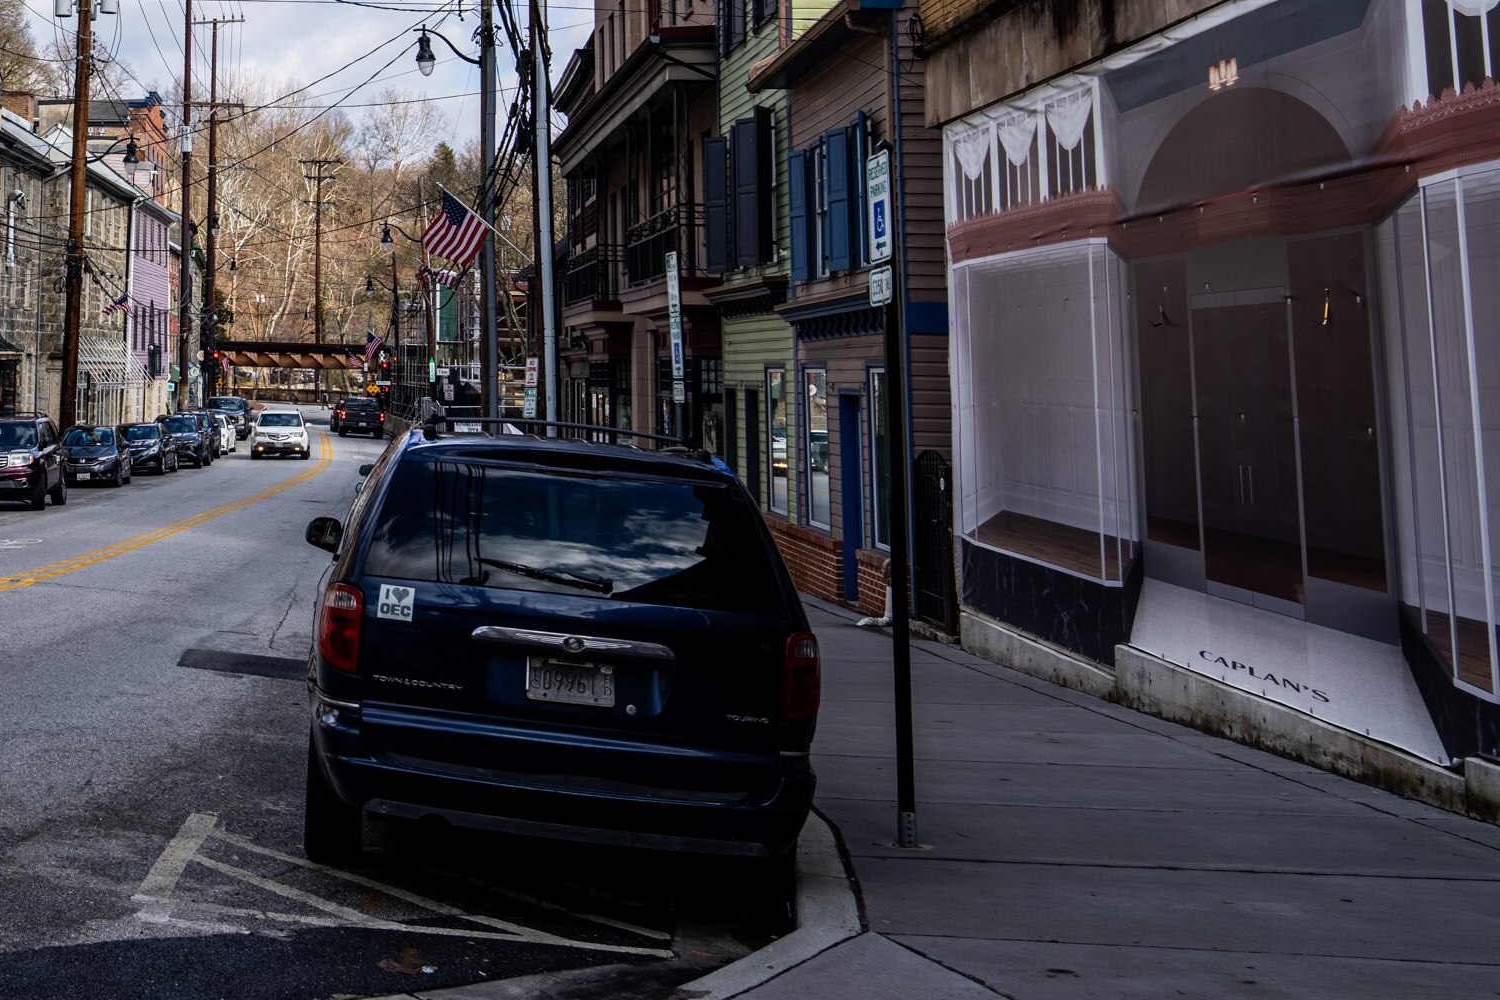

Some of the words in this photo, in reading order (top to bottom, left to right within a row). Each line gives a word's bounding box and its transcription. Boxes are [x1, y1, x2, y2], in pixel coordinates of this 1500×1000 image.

[385, 588, 390, 600] I
[379, 602, 412, 618] OEC
[373, 674, 403, 684] TOWN
[404, 678, 411, 686] &
[411, 680, 463, 690] COUNTRY
[542, 669, 595, 696] 09961
[1199, 650, 1330, 703] CAPLAN'S
